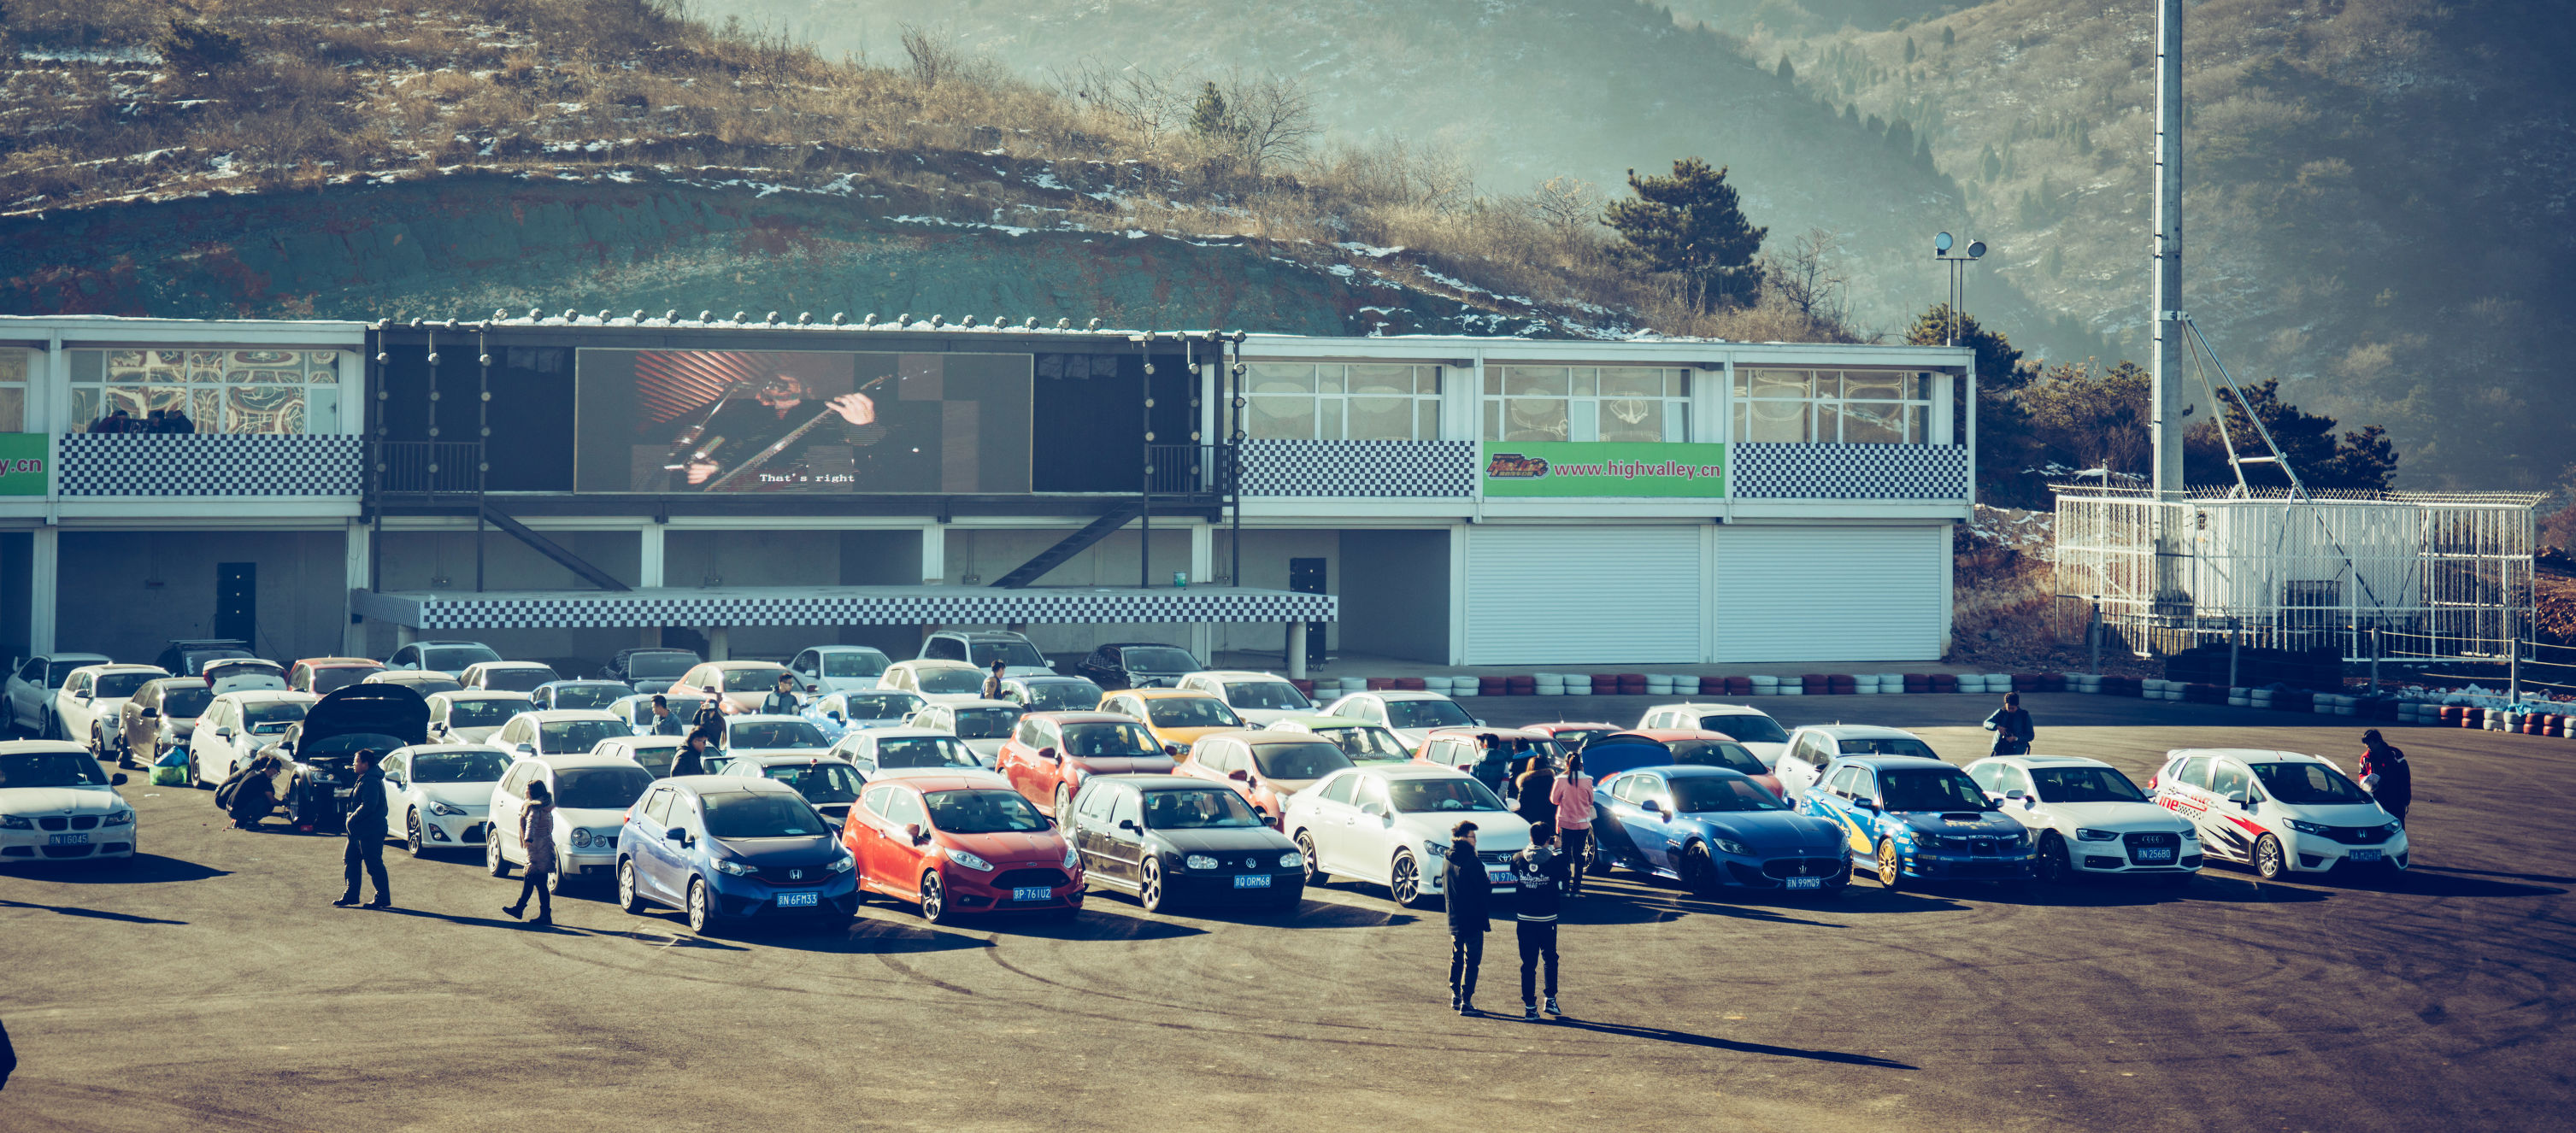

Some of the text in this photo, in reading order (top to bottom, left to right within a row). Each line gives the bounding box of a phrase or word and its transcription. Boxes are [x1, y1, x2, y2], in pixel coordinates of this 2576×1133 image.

[1554, 461, 1721, 479] www.highvalley.cn
[759, 473, 856, 484] That's right
